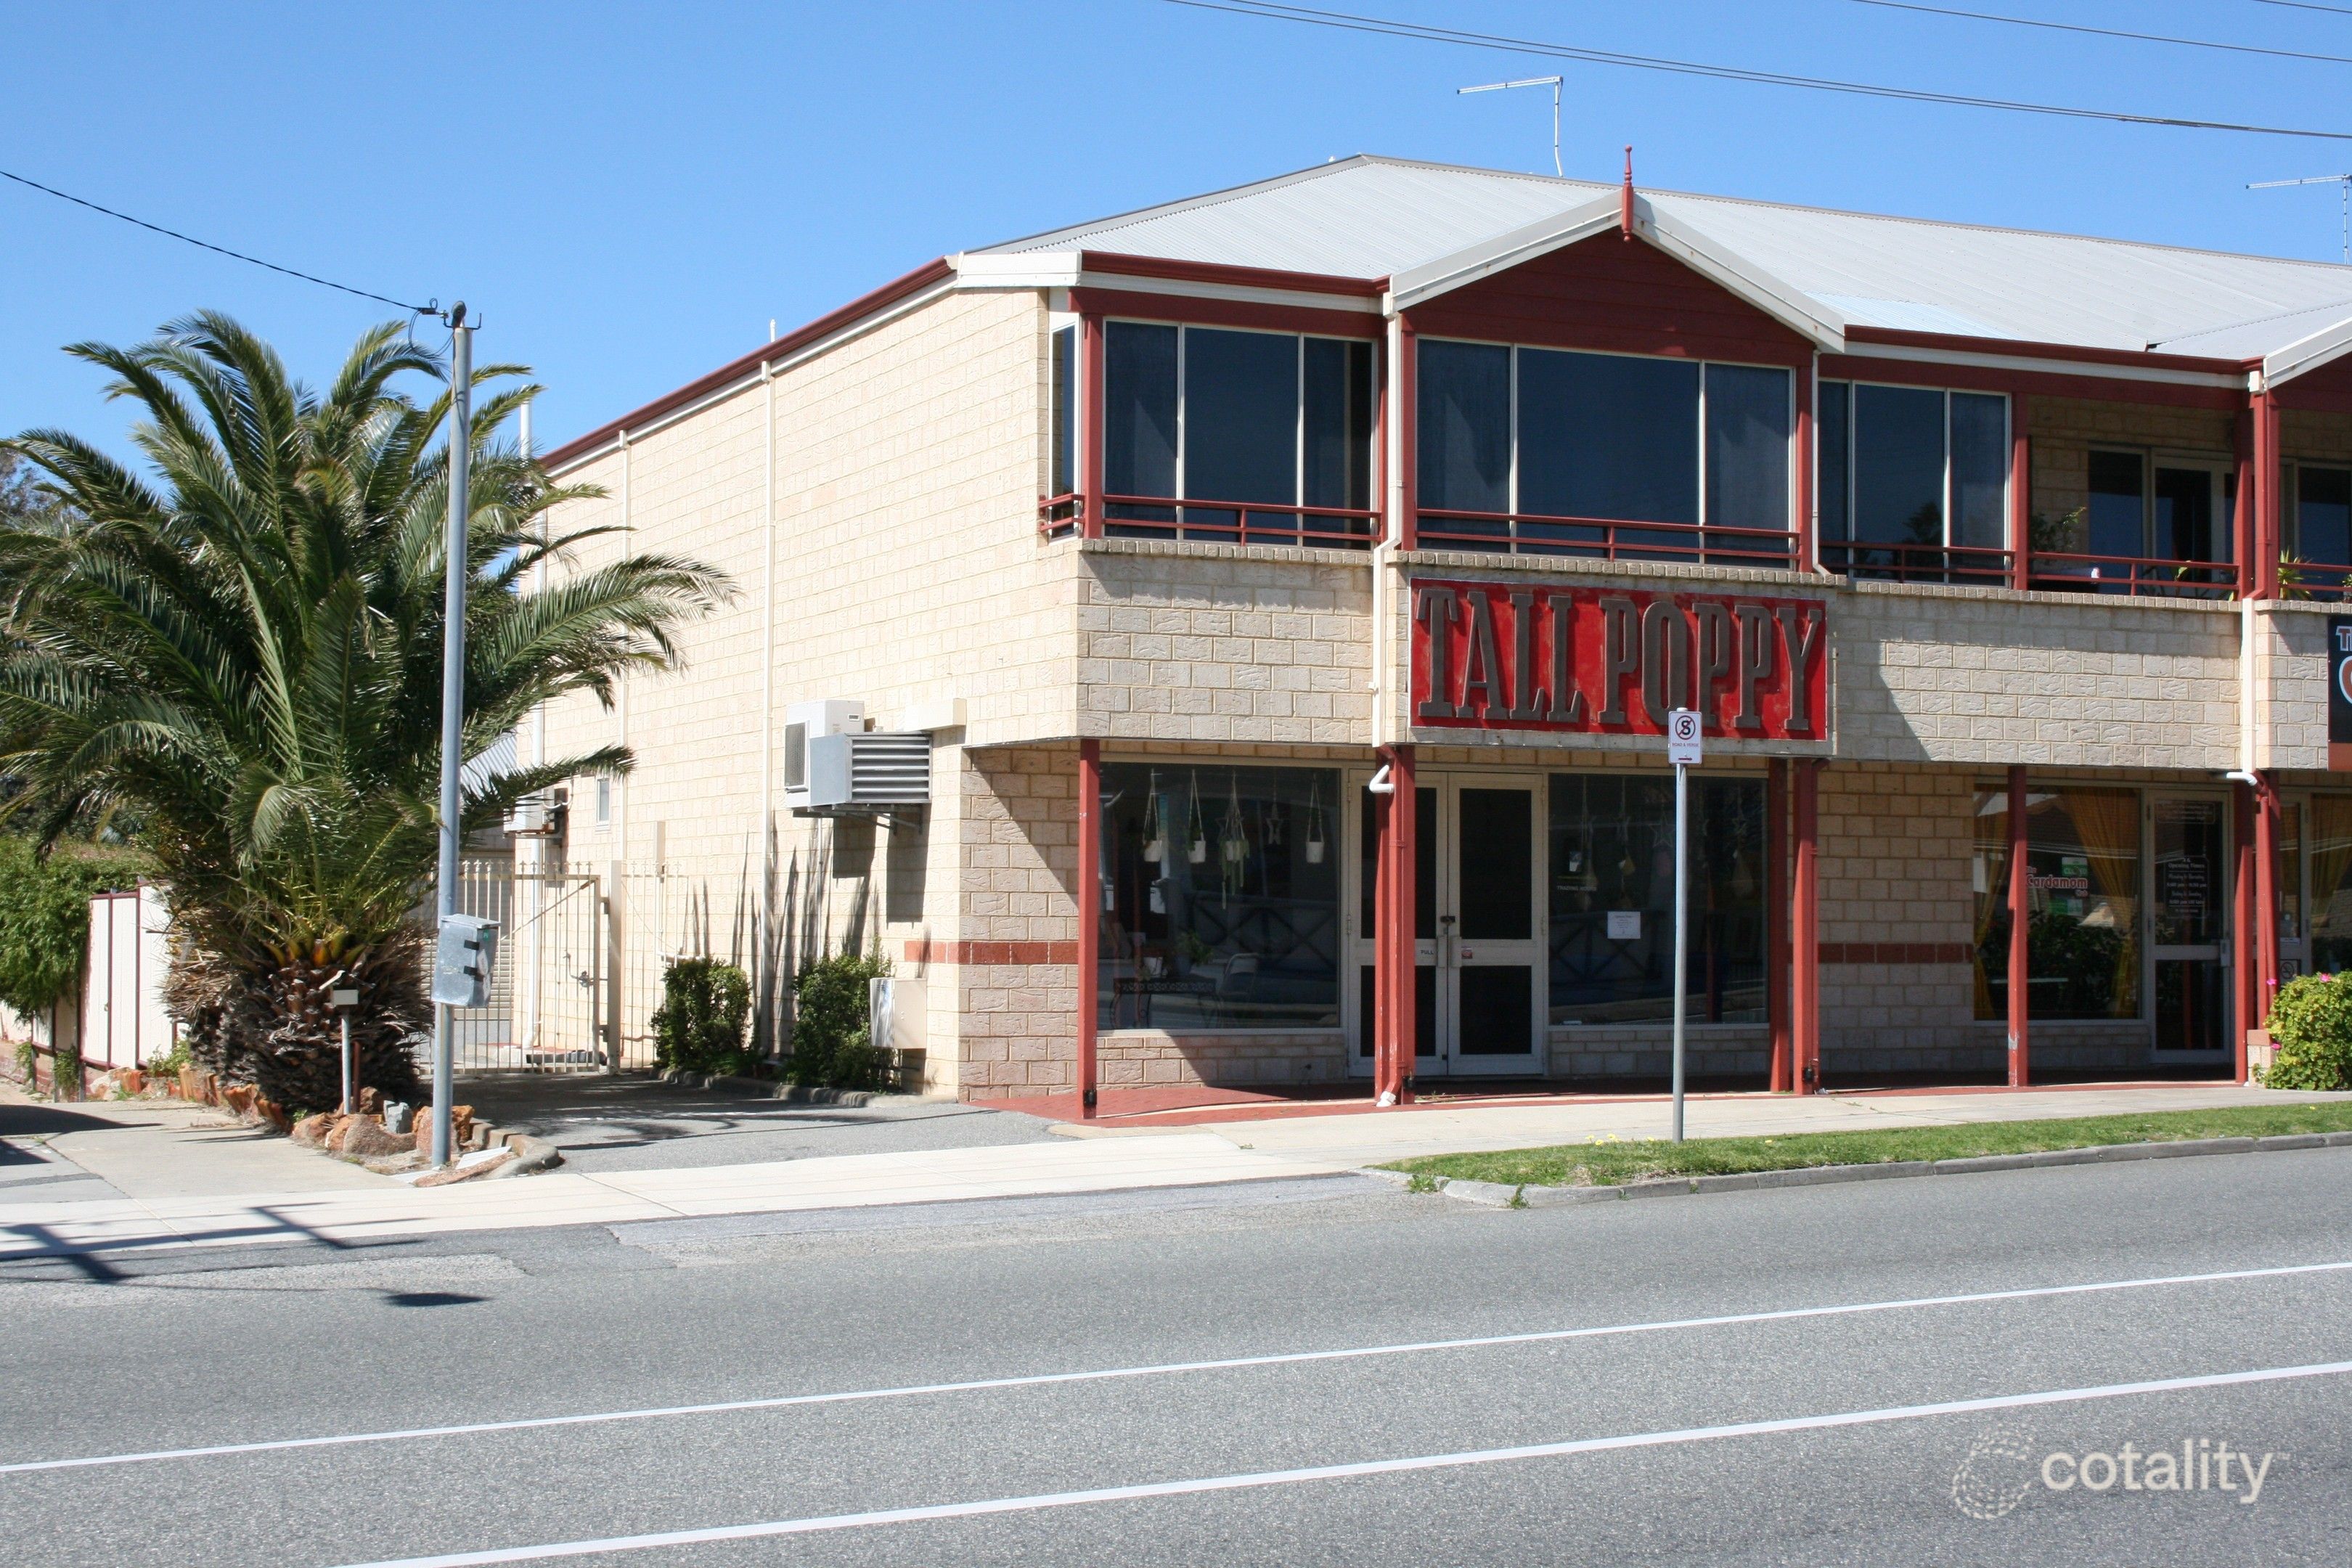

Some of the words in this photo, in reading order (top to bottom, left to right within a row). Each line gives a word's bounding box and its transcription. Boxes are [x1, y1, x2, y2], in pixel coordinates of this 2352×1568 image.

[1416, 588, 1583, 723] TALL
[1598, 597, 1823, 731] POPPY
[2026, 874, 2088, 889] Cardamom
